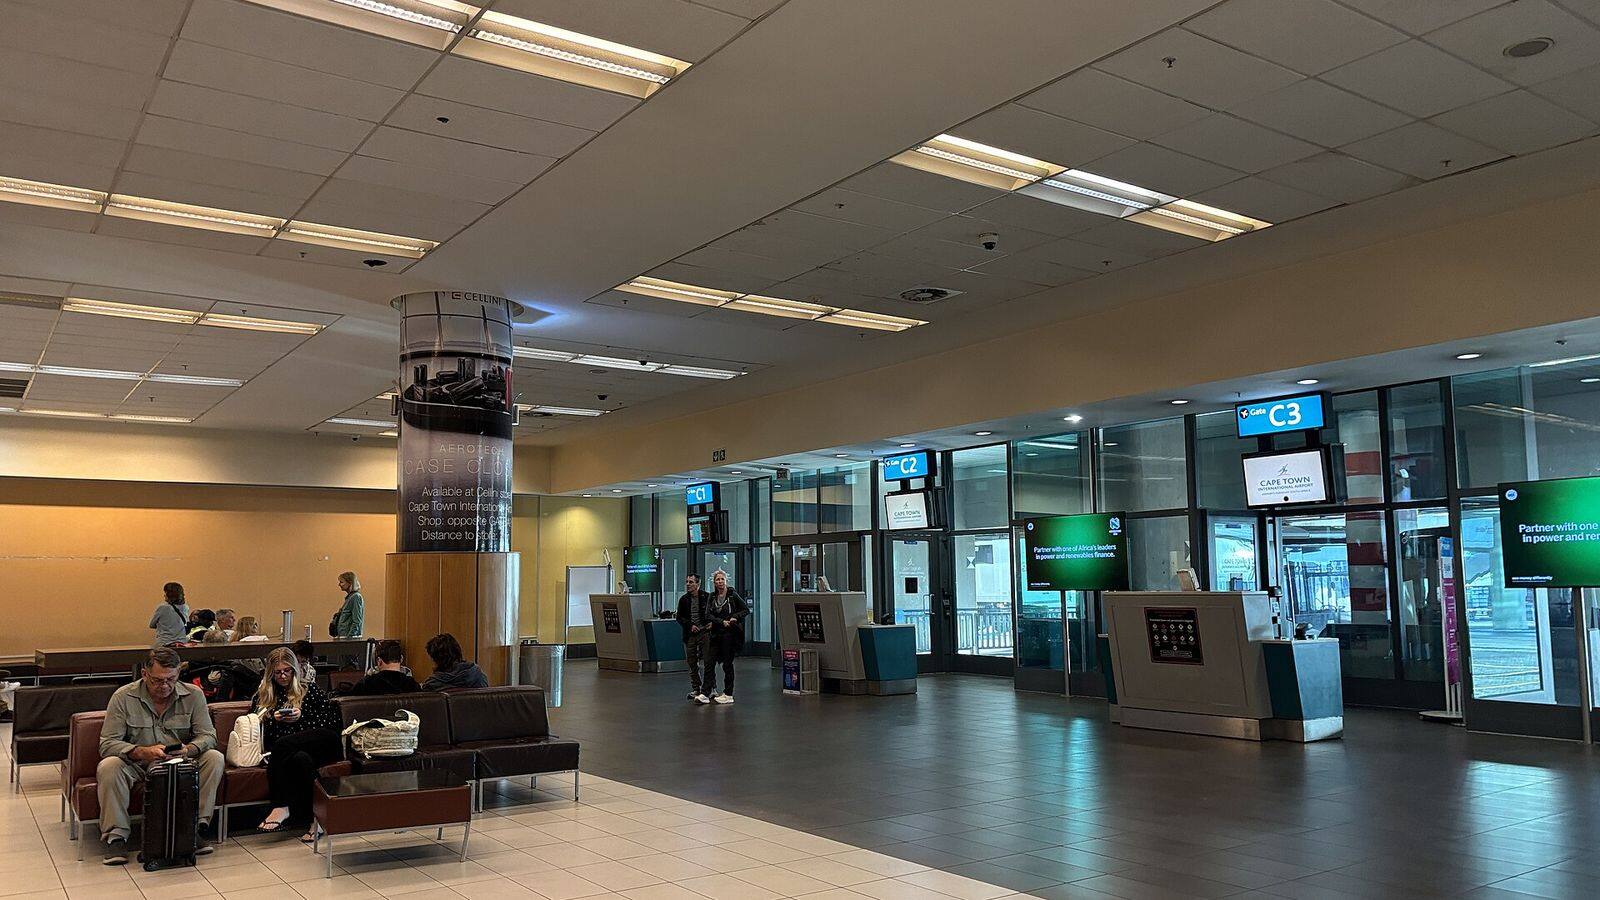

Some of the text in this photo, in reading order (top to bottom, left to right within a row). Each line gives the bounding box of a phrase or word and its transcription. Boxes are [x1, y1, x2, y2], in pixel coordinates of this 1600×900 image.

[464, 291, 501, 306] CELLINI
[1250, 402, 1302, 427] Gate C3
[405, 458, 455, 475] CASE
[900, 456, 918, 474] C2
[1260, 476, 1311, 487] CAPE TOWN
[422, 486, 462, 497] Available
[465, 487, 475, 497] at
[696, 487, 706, 500] C1
[408, 501, 429, 513] Cape
[432, 500, 457, 511] Town
[418, 515, 444, 527] Shop:
[1519, 522, 1598, 533] Partner with one
[422, 529, 462, 541] Distance
[465, 530, 475, 541] to
[1522, 533, 1532, 543] in
[1533, 534, 1564, 543] power
[1565, 532, 1584, 542] and
[1097, 543, 1117, 551] leaders
[1041, 553, 1056, 561] power
[1056, 552, 1066, 560] and
[1066, 551, 1094, 559] renewables
[1094, 551, 1116, 559] finance.
